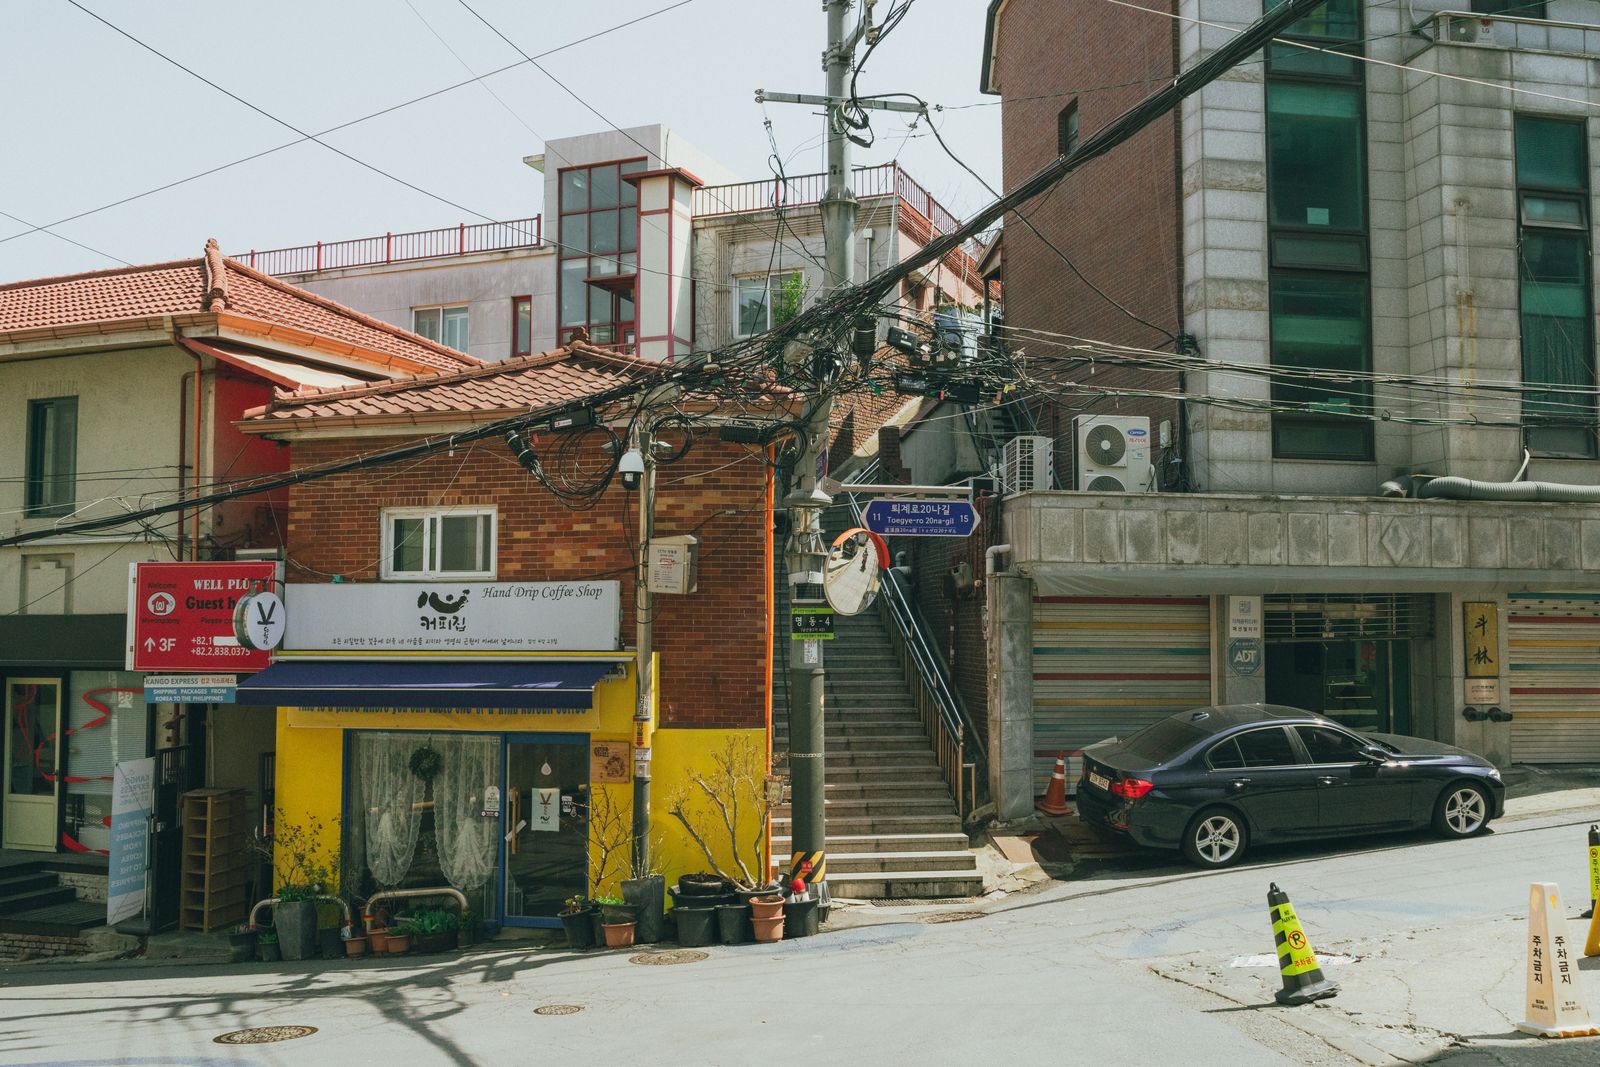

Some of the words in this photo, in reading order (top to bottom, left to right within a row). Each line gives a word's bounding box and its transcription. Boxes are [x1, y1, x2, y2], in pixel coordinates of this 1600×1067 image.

[891, 504, 950, 516] 퇴계로20나길
[873, 513, 881, 521] 11
[888, 516, 924, 526] Toegye-ro
[925, 517, 955, 526] 20na-gil
[960, 515, 969, 523] 15
[193, 580, 224, 590] WELL
[482, 585, 514, 599] Hand
[514, 586, 539, 601] Drip
[541, 584, 574, 601] Coffee
[577, 584, 602, 600] Shop
[185, 596, 224, 610] Guest
[420, 616, 466, 632] 커피집
[159, 638, 176, 652] 3F
[1233, 650, 1258, 663] ADT
[144, 677, 170, 686] KANGO
[171, 677, 199, 685] EXPRESS
[1532, 935, 1543, 984] 주차금지
[1554, 936, 1571, 984] 주차금지
